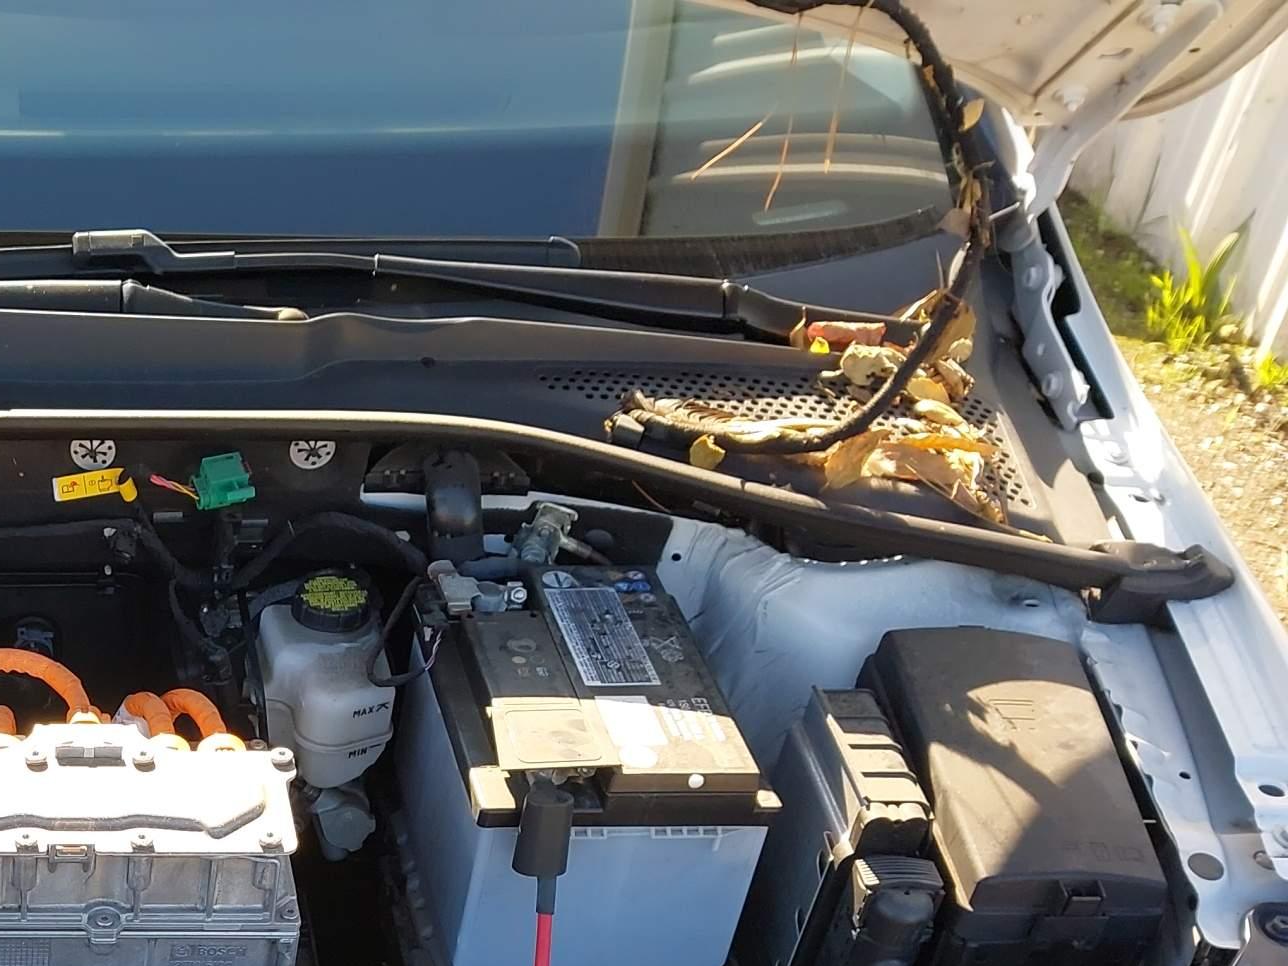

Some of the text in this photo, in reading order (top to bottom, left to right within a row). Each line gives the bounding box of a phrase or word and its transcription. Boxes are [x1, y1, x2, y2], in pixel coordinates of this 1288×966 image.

[352, 705, 374, 718] MAX
[348, 747, 368, 759] MIN
[198, 943, 248, 957] BOSCH
